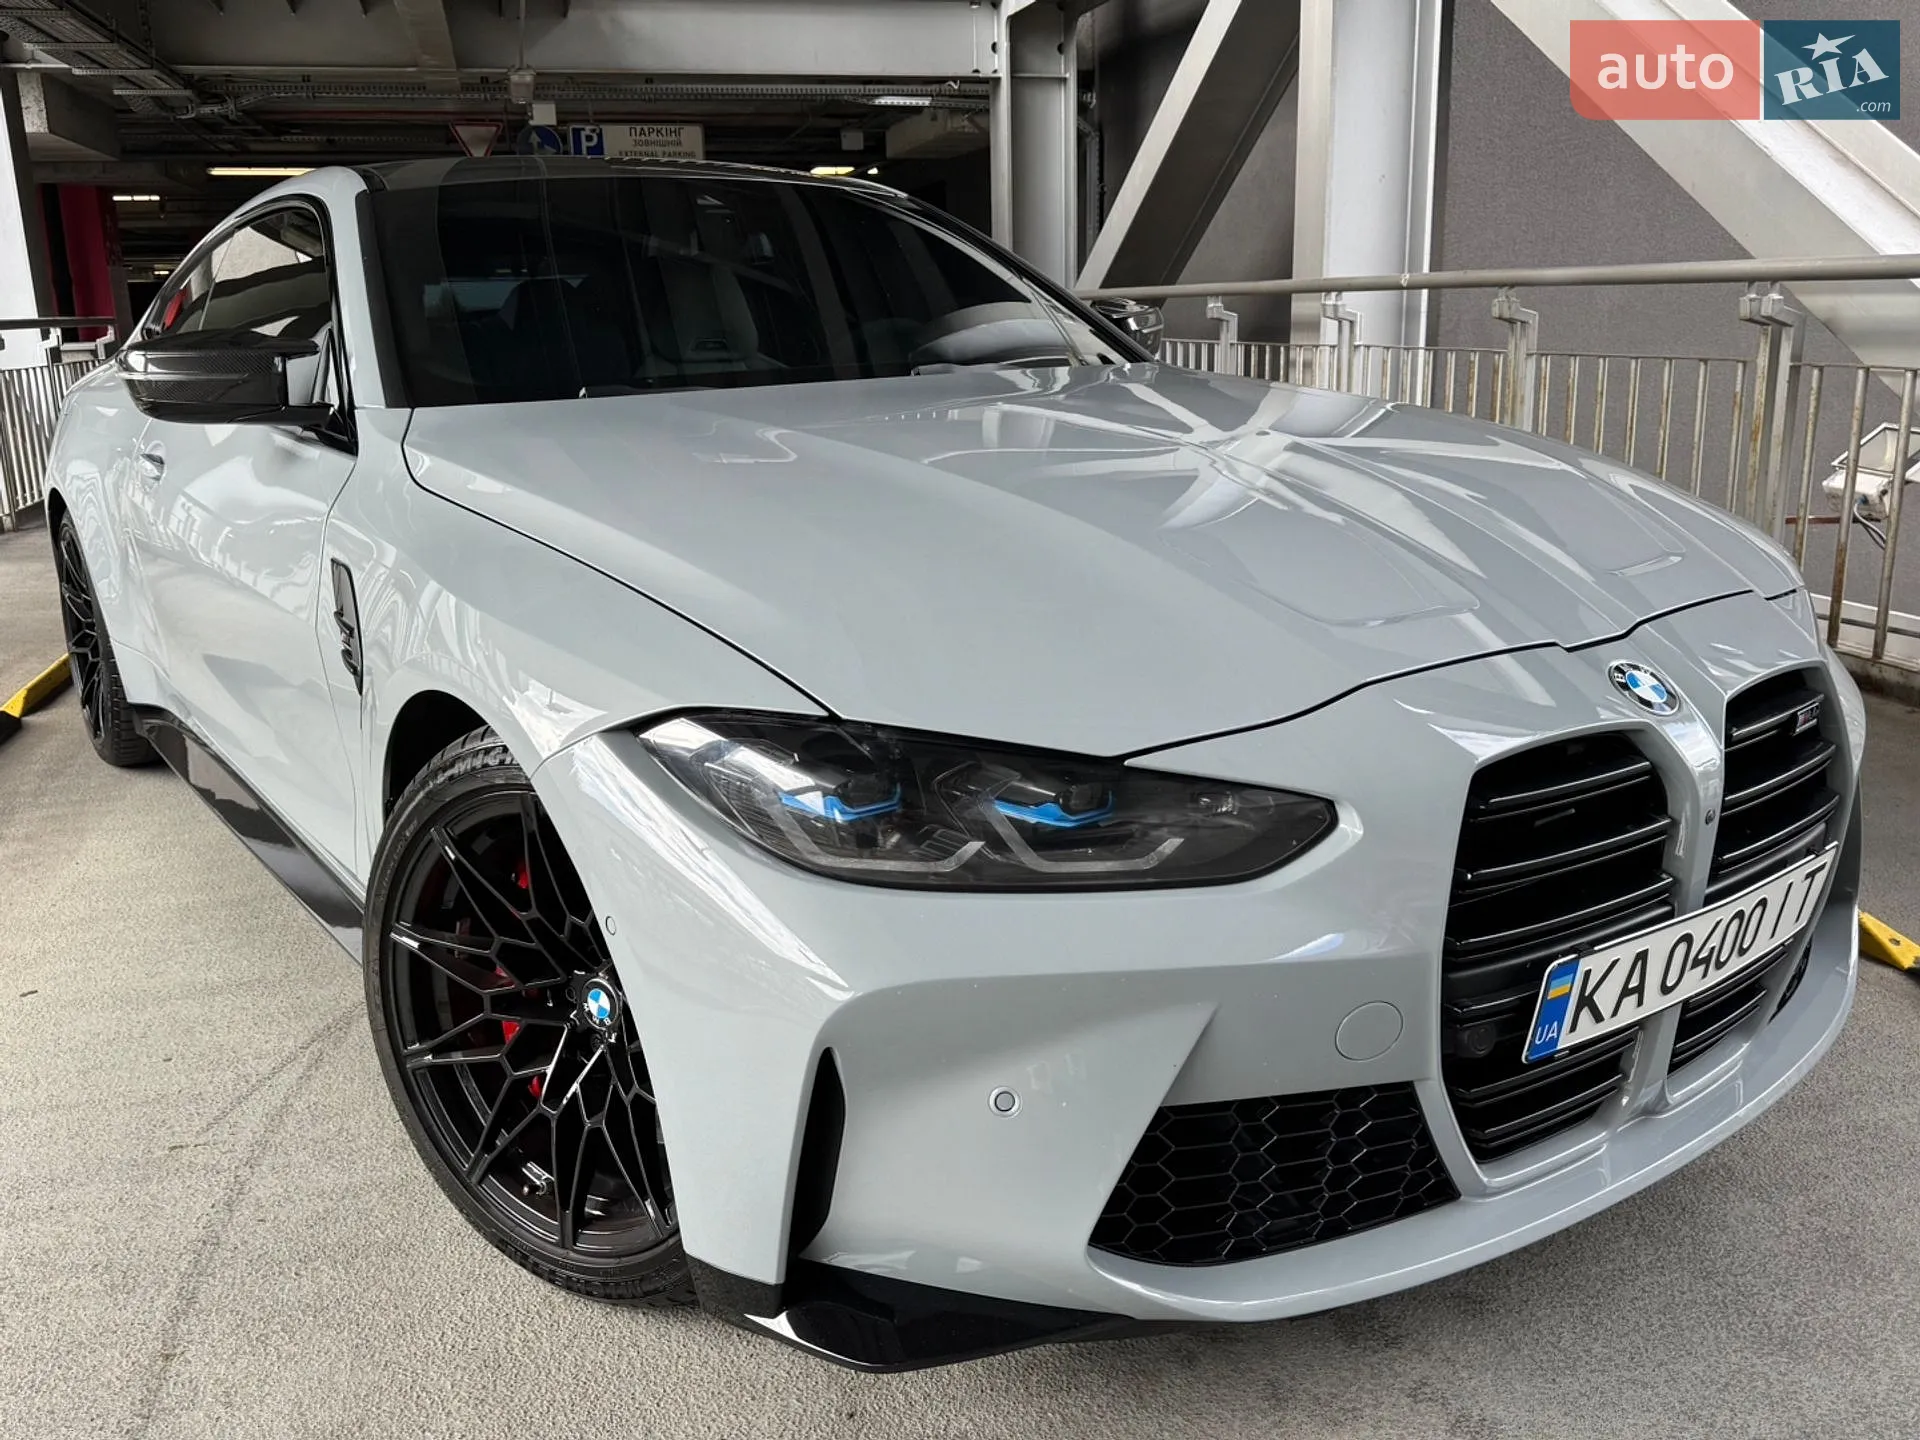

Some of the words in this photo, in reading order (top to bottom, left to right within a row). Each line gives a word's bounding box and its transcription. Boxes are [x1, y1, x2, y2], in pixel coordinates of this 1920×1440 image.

[629, 126, 685, 138] ПАРКІНГ
[632, 138, 683, 148] ЗОВНІШНІЙ
[662, 151, 697, 159] PARKING
[1568, 947, 1650, 1034] KA
[1659, 895, 1769, 997] 0400
[1534, 1020, 1559, 1045] UA
